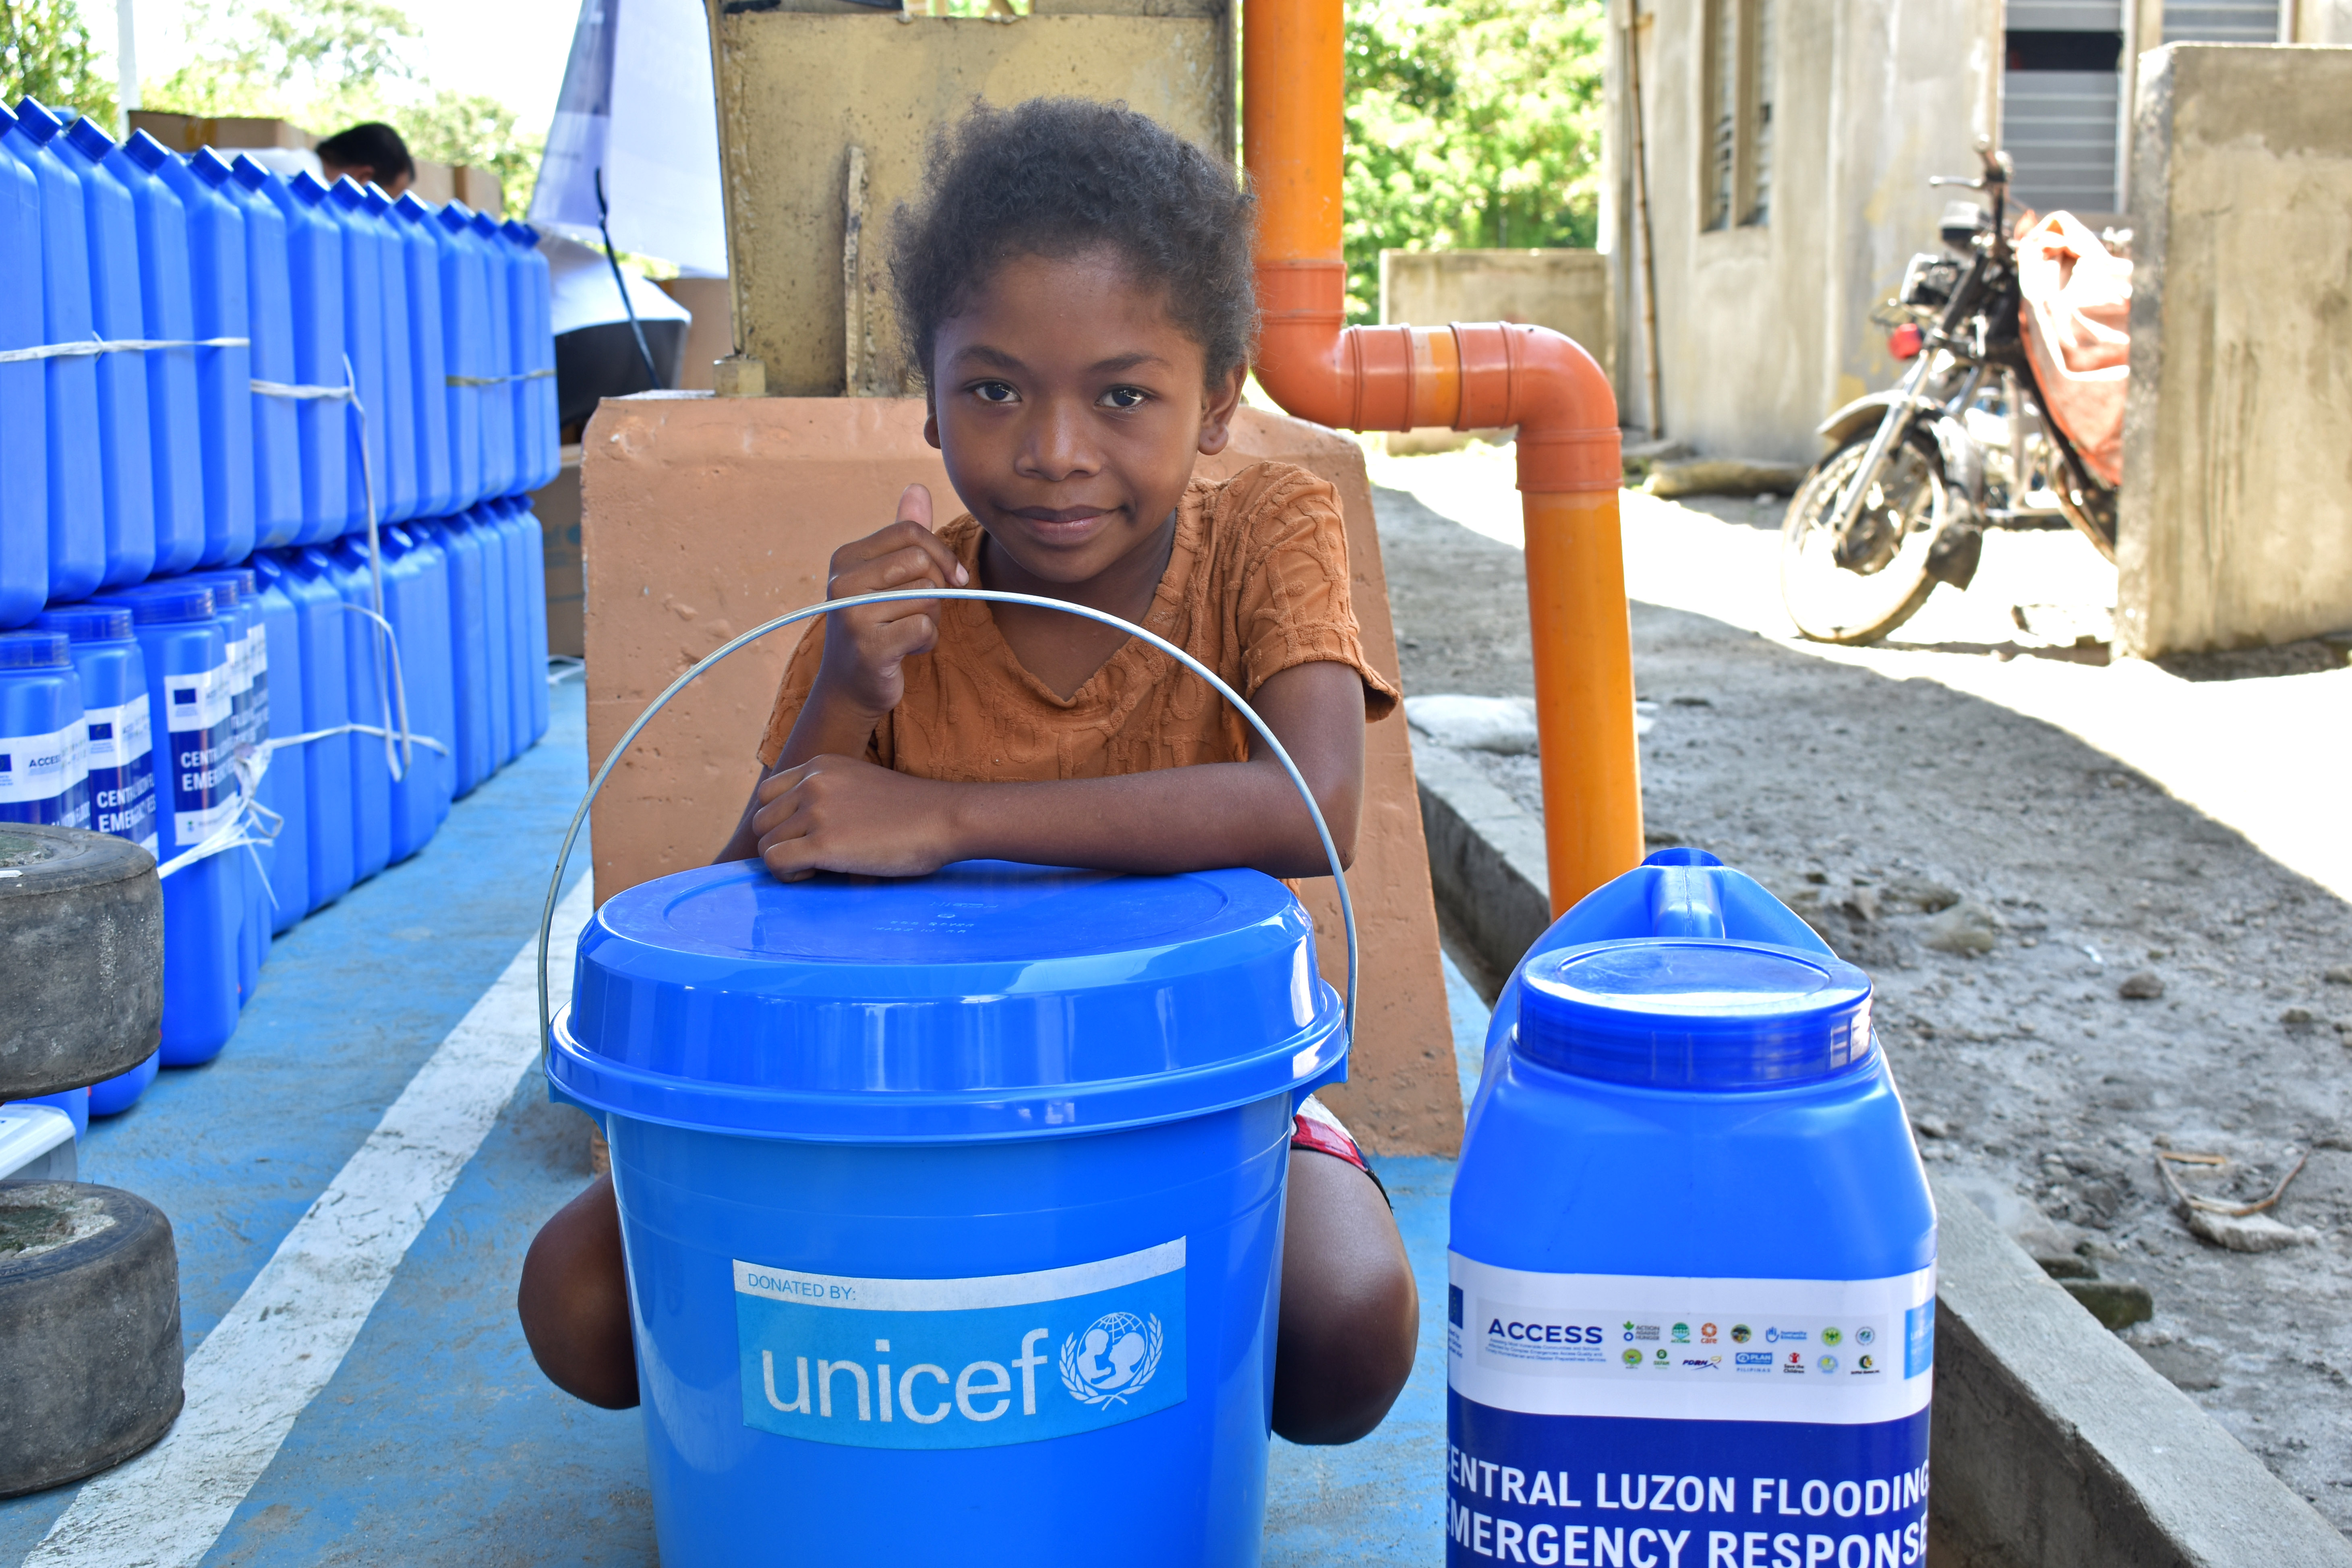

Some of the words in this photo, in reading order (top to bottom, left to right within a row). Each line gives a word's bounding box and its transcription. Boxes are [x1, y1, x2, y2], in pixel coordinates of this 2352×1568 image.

[748, 1273, 824, 1297] DONATED
[830, 1286, 856, 1301] BY:
[1488, 1319, 1603, 1344] ACCESS
[763, 1328, 1048, 1424] unicef
[1597, 1473, 1735, 1513] LUZON
[1753, 1459, 1929, 1518] FLOODING
[1447, 1490, 1691, 1568] MERGENCY
[1708, 1510, 1927, 1568] RESPONSE
